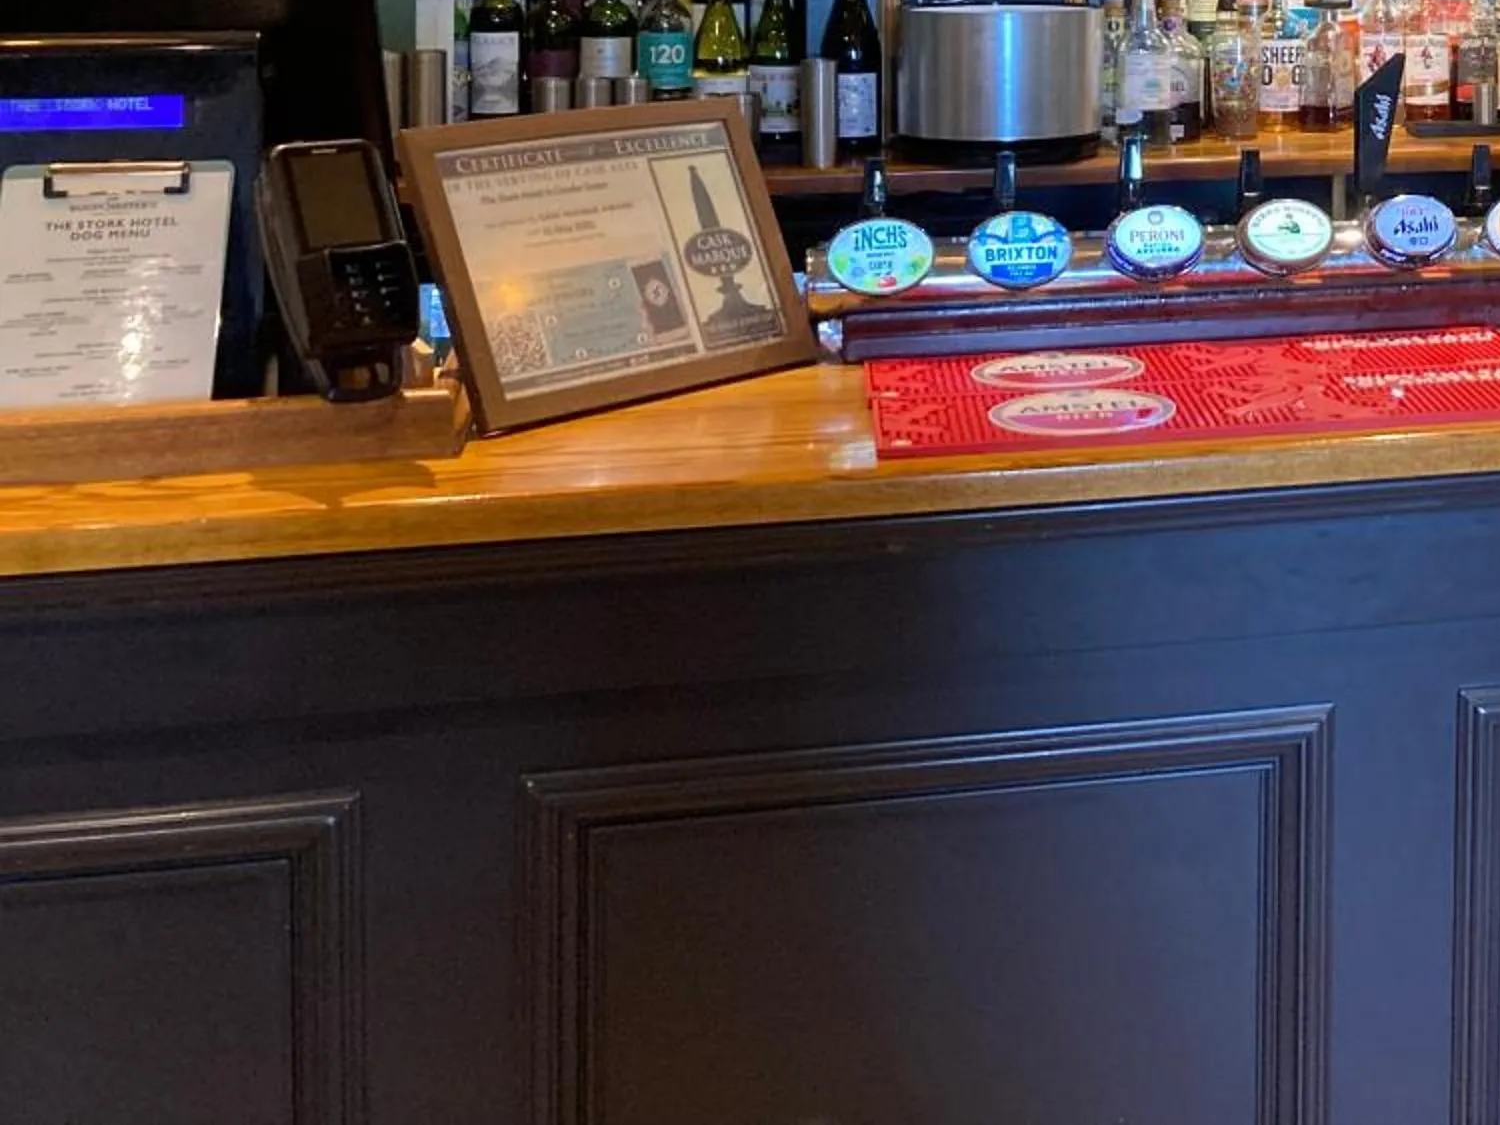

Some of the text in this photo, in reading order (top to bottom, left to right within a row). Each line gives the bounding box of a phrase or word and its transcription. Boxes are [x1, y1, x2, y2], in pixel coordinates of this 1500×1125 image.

[649, 44, 685, 64] 120
[107, 96, 154, 111] HOTEL
[1369, 93, 1393, 140] Asahi
[77, 218, 125, 231] STORK
[130, 216, 178, 228] HOTEL
[1393, 214, 1439, 236] Asahi
[107, 227, 151, 241] MENU
[696, 234, 732, 250] CASK
[1129, 229, 1185, 244] PERONI
[984, 245, 1058, 263] BRIXTON
